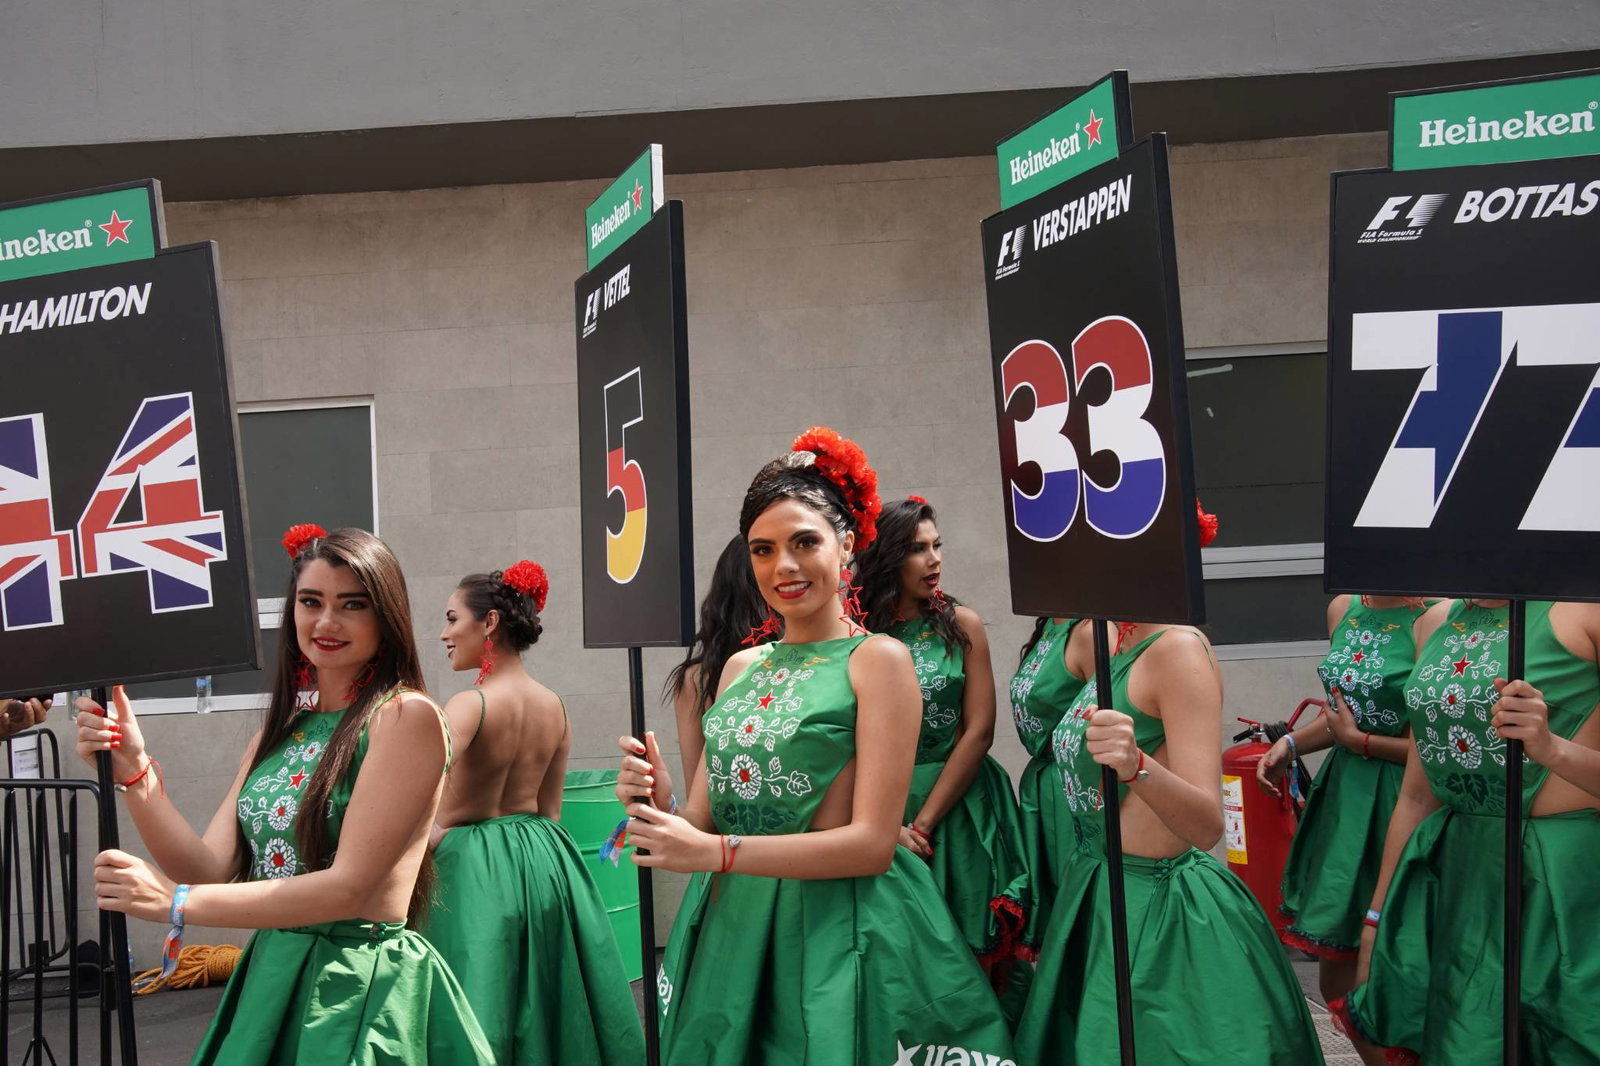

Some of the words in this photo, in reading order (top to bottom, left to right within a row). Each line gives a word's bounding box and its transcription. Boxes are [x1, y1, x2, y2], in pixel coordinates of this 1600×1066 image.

[1419, 110, 1596, 148] Heineken
[1009, 131, 1081, 186] Heineken
[591, 198, 631, 250] Heineken
[1033, 174, 1132, 251] VERSTAPPEN
[1366, 193, 1449, 230] F1
[1453, 179, 1600, 224] BOTTAS
[997, 225, 1027, 267] F1
[0, 282, 152, 335] HAMILTON
[604, 264, 631, 311] VETTEL
[1001, 315, 1166, 543] 33
[1352, 303, 1600, 532] 77
[604, 366, 647, 584] 5
[0, 391, 228, 632] 44
